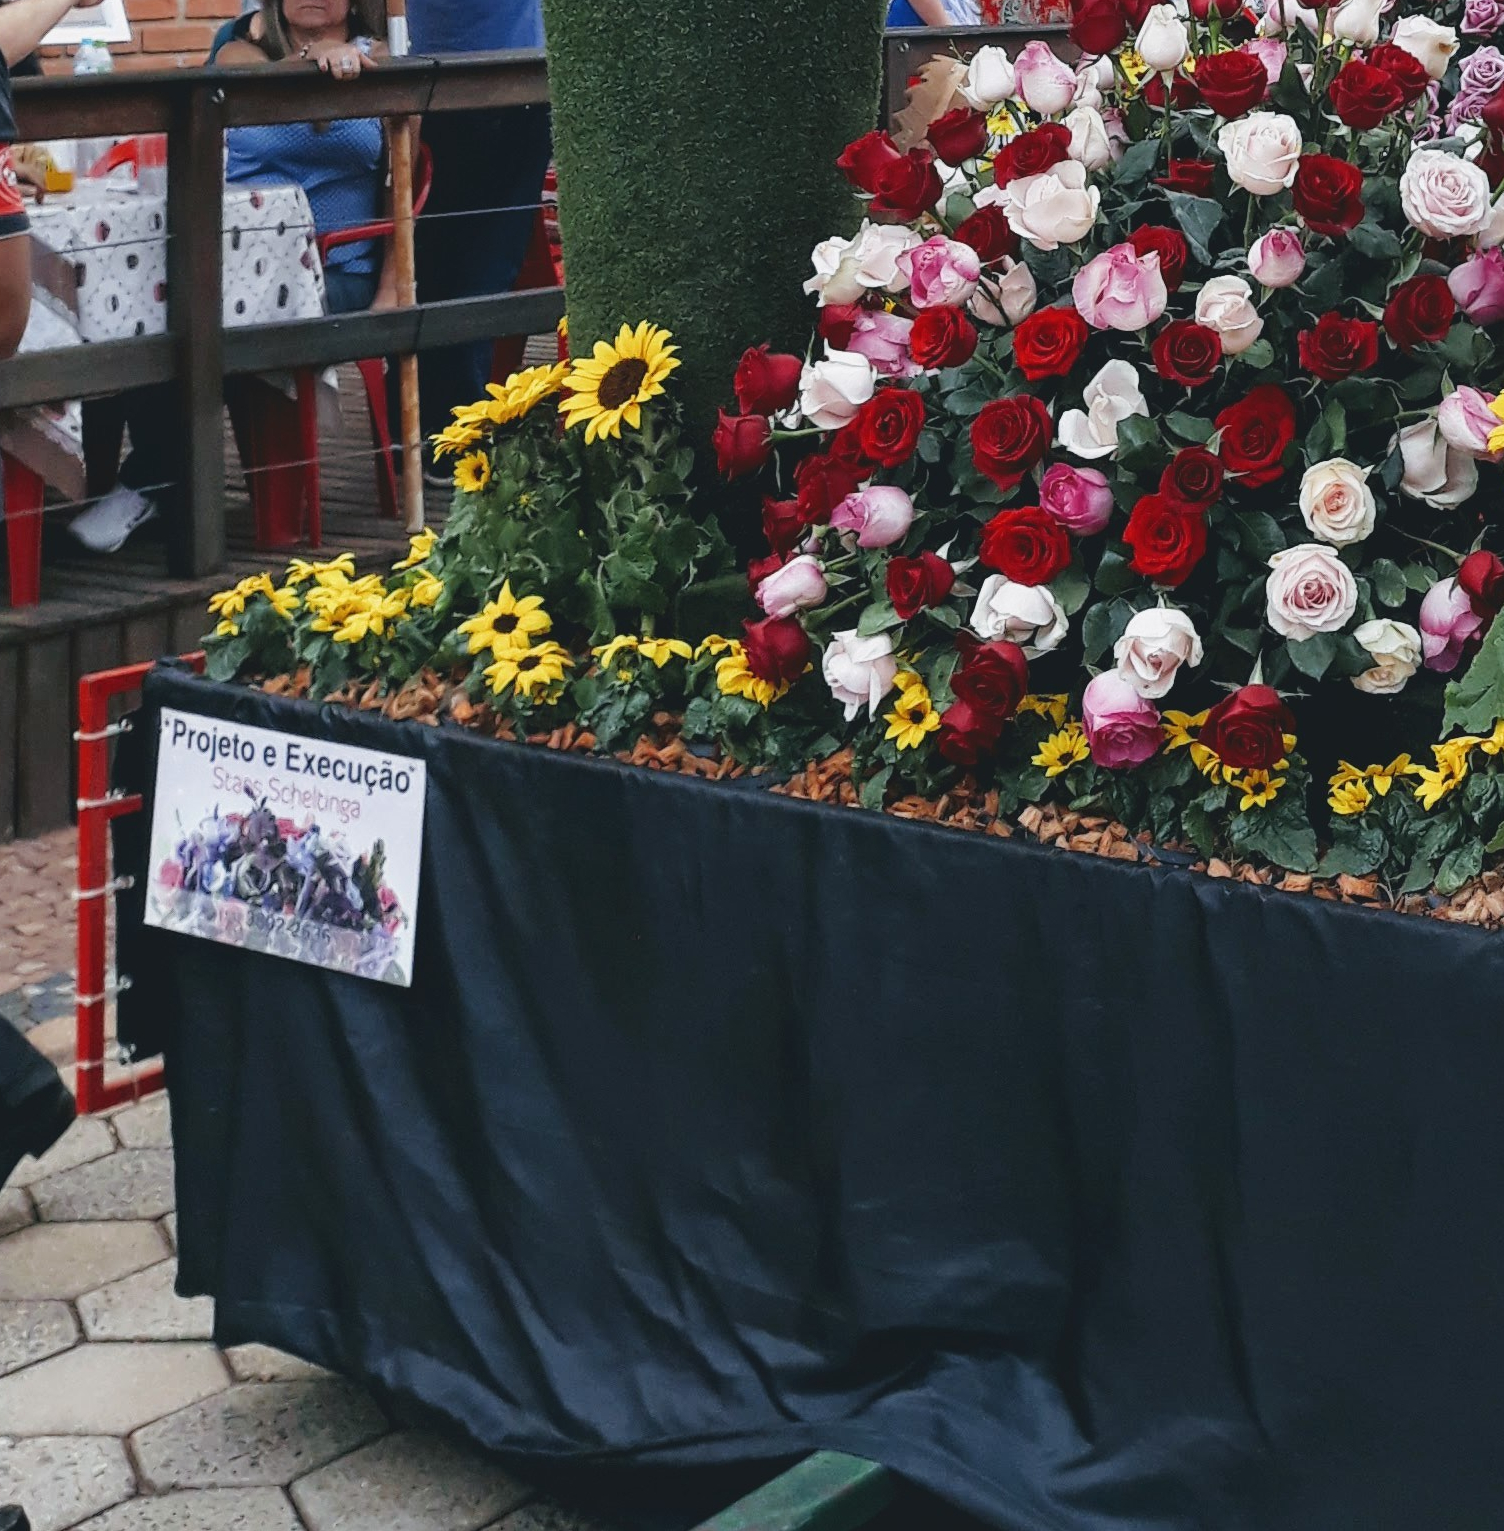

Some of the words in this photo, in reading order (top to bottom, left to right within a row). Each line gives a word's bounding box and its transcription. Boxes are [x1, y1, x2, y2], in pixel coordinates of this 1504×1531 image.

[171, 719, 255, 763] Projeto
[263, 744, 277, 767] e
[285, 742, 411, 796] Execução
